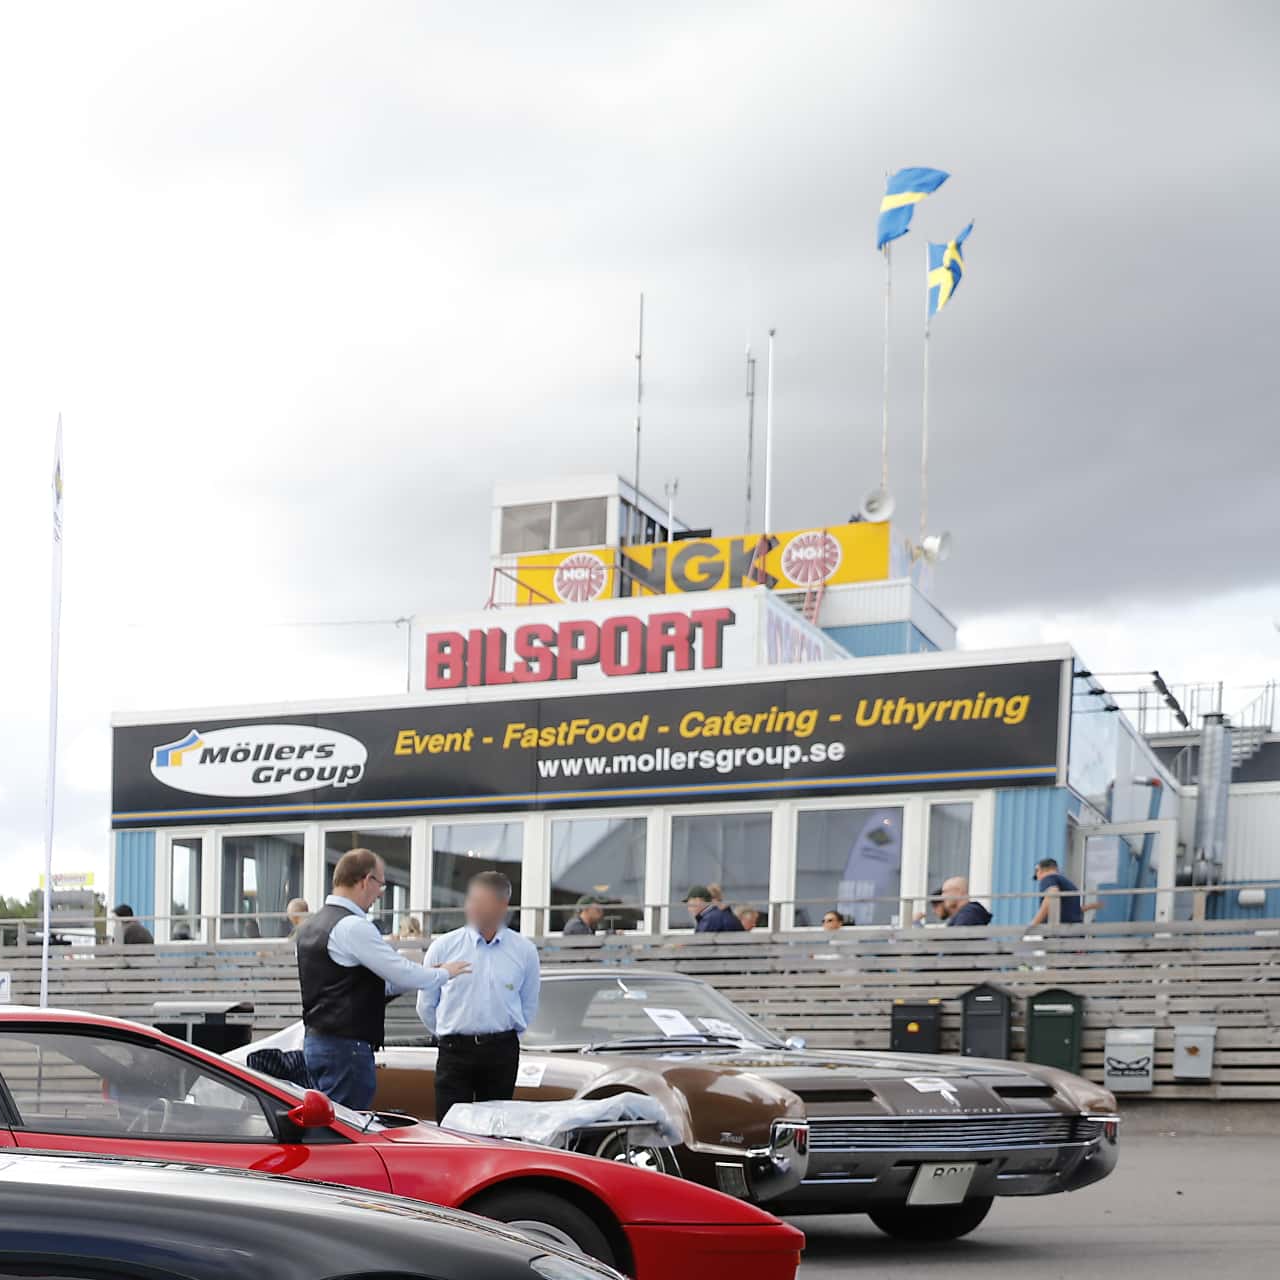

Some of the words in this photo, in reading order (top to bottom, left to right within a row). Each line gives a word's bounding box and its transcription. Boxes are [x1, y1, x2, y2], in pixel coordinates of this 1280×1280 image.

[620, 535, 780, 597] NGK
[425, 607, 736, 689] BILSPORT
[394, 726, 474, 756] Event
[502, 715, 649, 749] FastFood
[679, 705, 818, 739] Catering
[855, 691, 1030, 731] Uthyrning
[198, 741, 336, 765] Möllers
[251, 760, 362, 785] Group
[538, 740, 846, 778] www.mollersgroup.se
